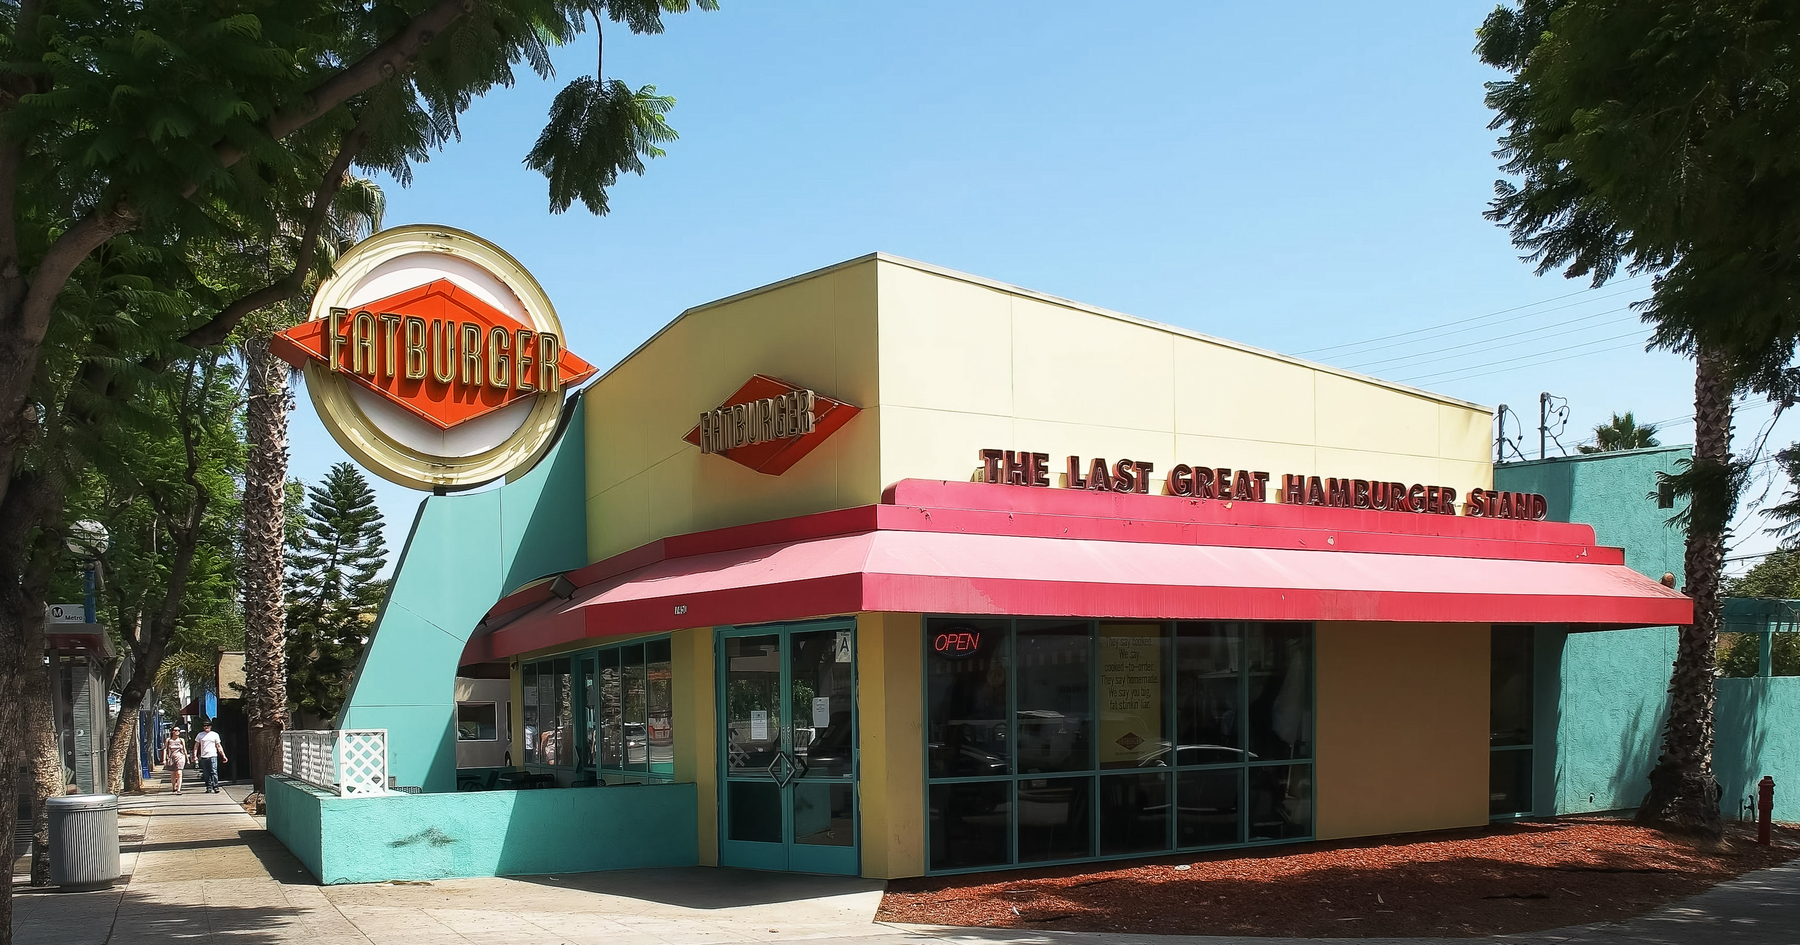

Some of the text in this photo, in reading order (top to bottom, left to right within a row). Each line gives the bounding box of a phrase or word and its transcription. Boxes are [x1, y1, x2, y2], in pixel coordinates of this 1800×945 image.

[329, 307, 560, 393] FATBURGER
[700, 389, 815, 454] FATBURGER
[980, 449, 1547, 521] THE LAST GREAT HAMBURGER STAND
[839, 636, 850, 652] A
[934, 632, 980, 651] OPEN
[1120, 638, 1130, 649] say
[1119, 649, 1139, 661] We say
[1101, 674, 1159, 687] They say homemade.
[1108, 687, 1117, 698] We
[1119, 689, 1129, 699] say
[1131, 689, 1140, 699] you
